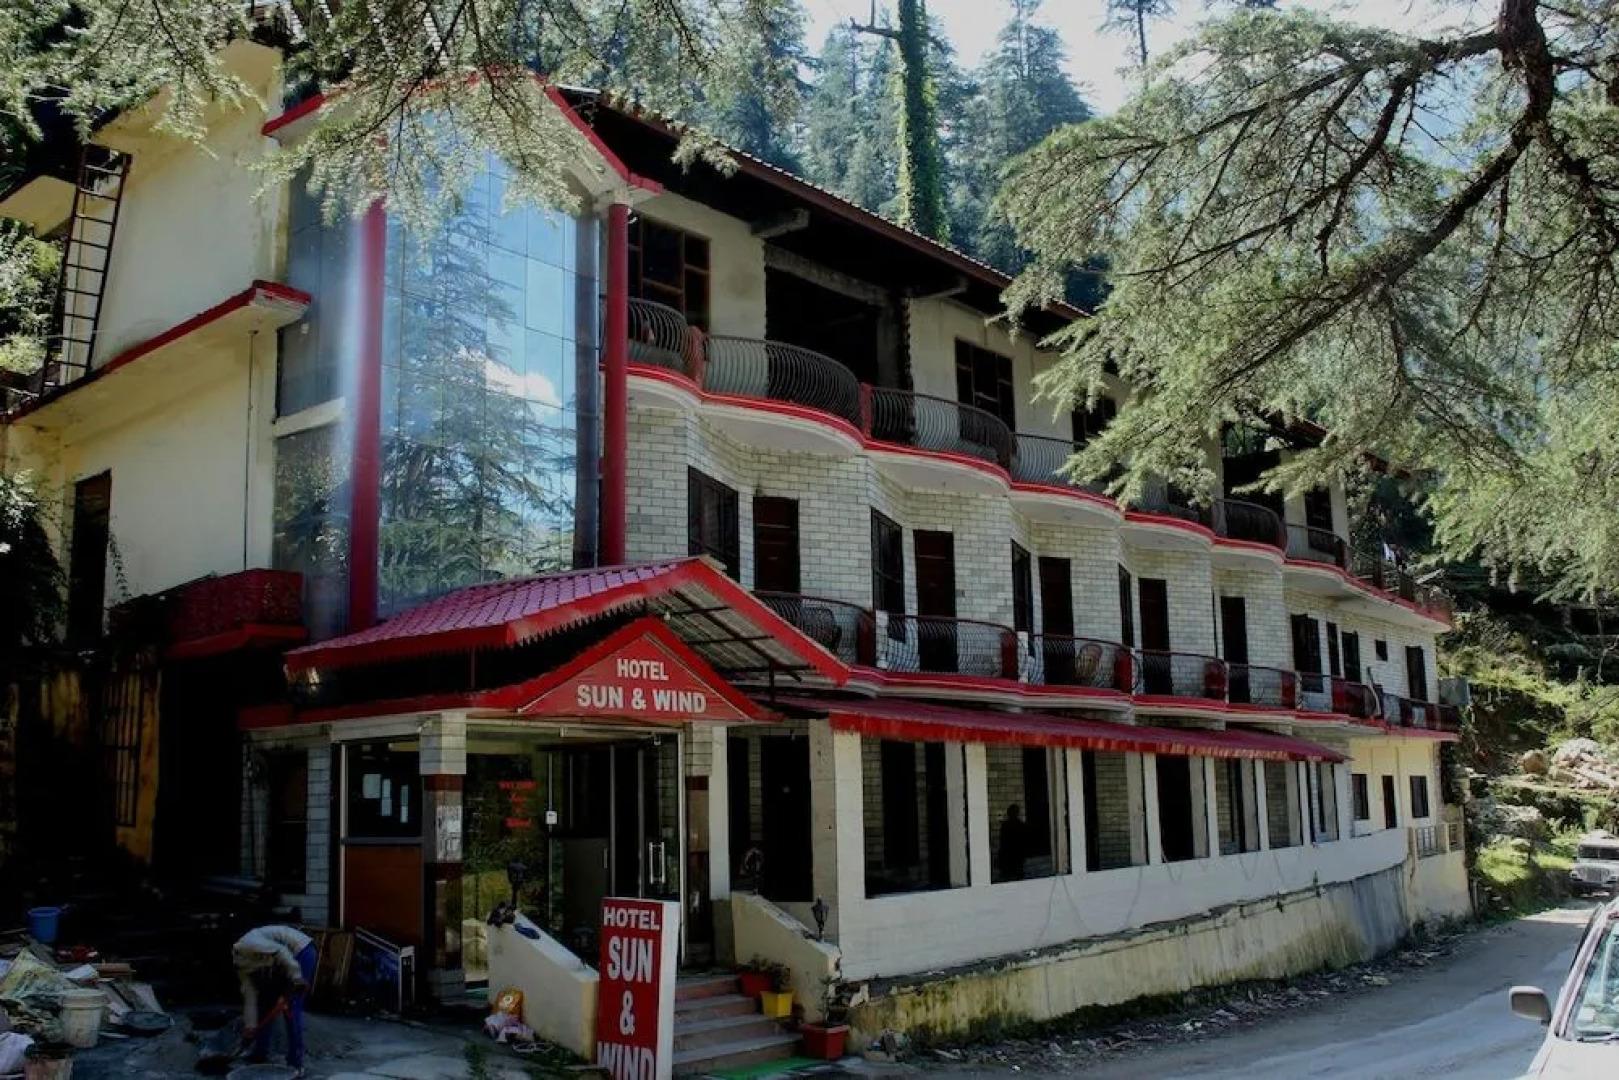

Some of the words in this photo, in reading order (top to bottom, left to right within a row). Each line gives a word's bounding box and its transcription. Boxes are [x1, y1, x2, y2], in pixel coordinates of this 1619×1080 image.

[617, 658, 669, 681] HOTEL
[577, 684, 624, 709] SUN
[631, 687, 647, 711] &
[652, 689, 707, 713] WIND
[603, 906, 661, 931] HOTEL
[607, 935, 654, 984] SUN
[619, 990, 636, 1036] &
[597, 1041, 655, 1080] WIND
